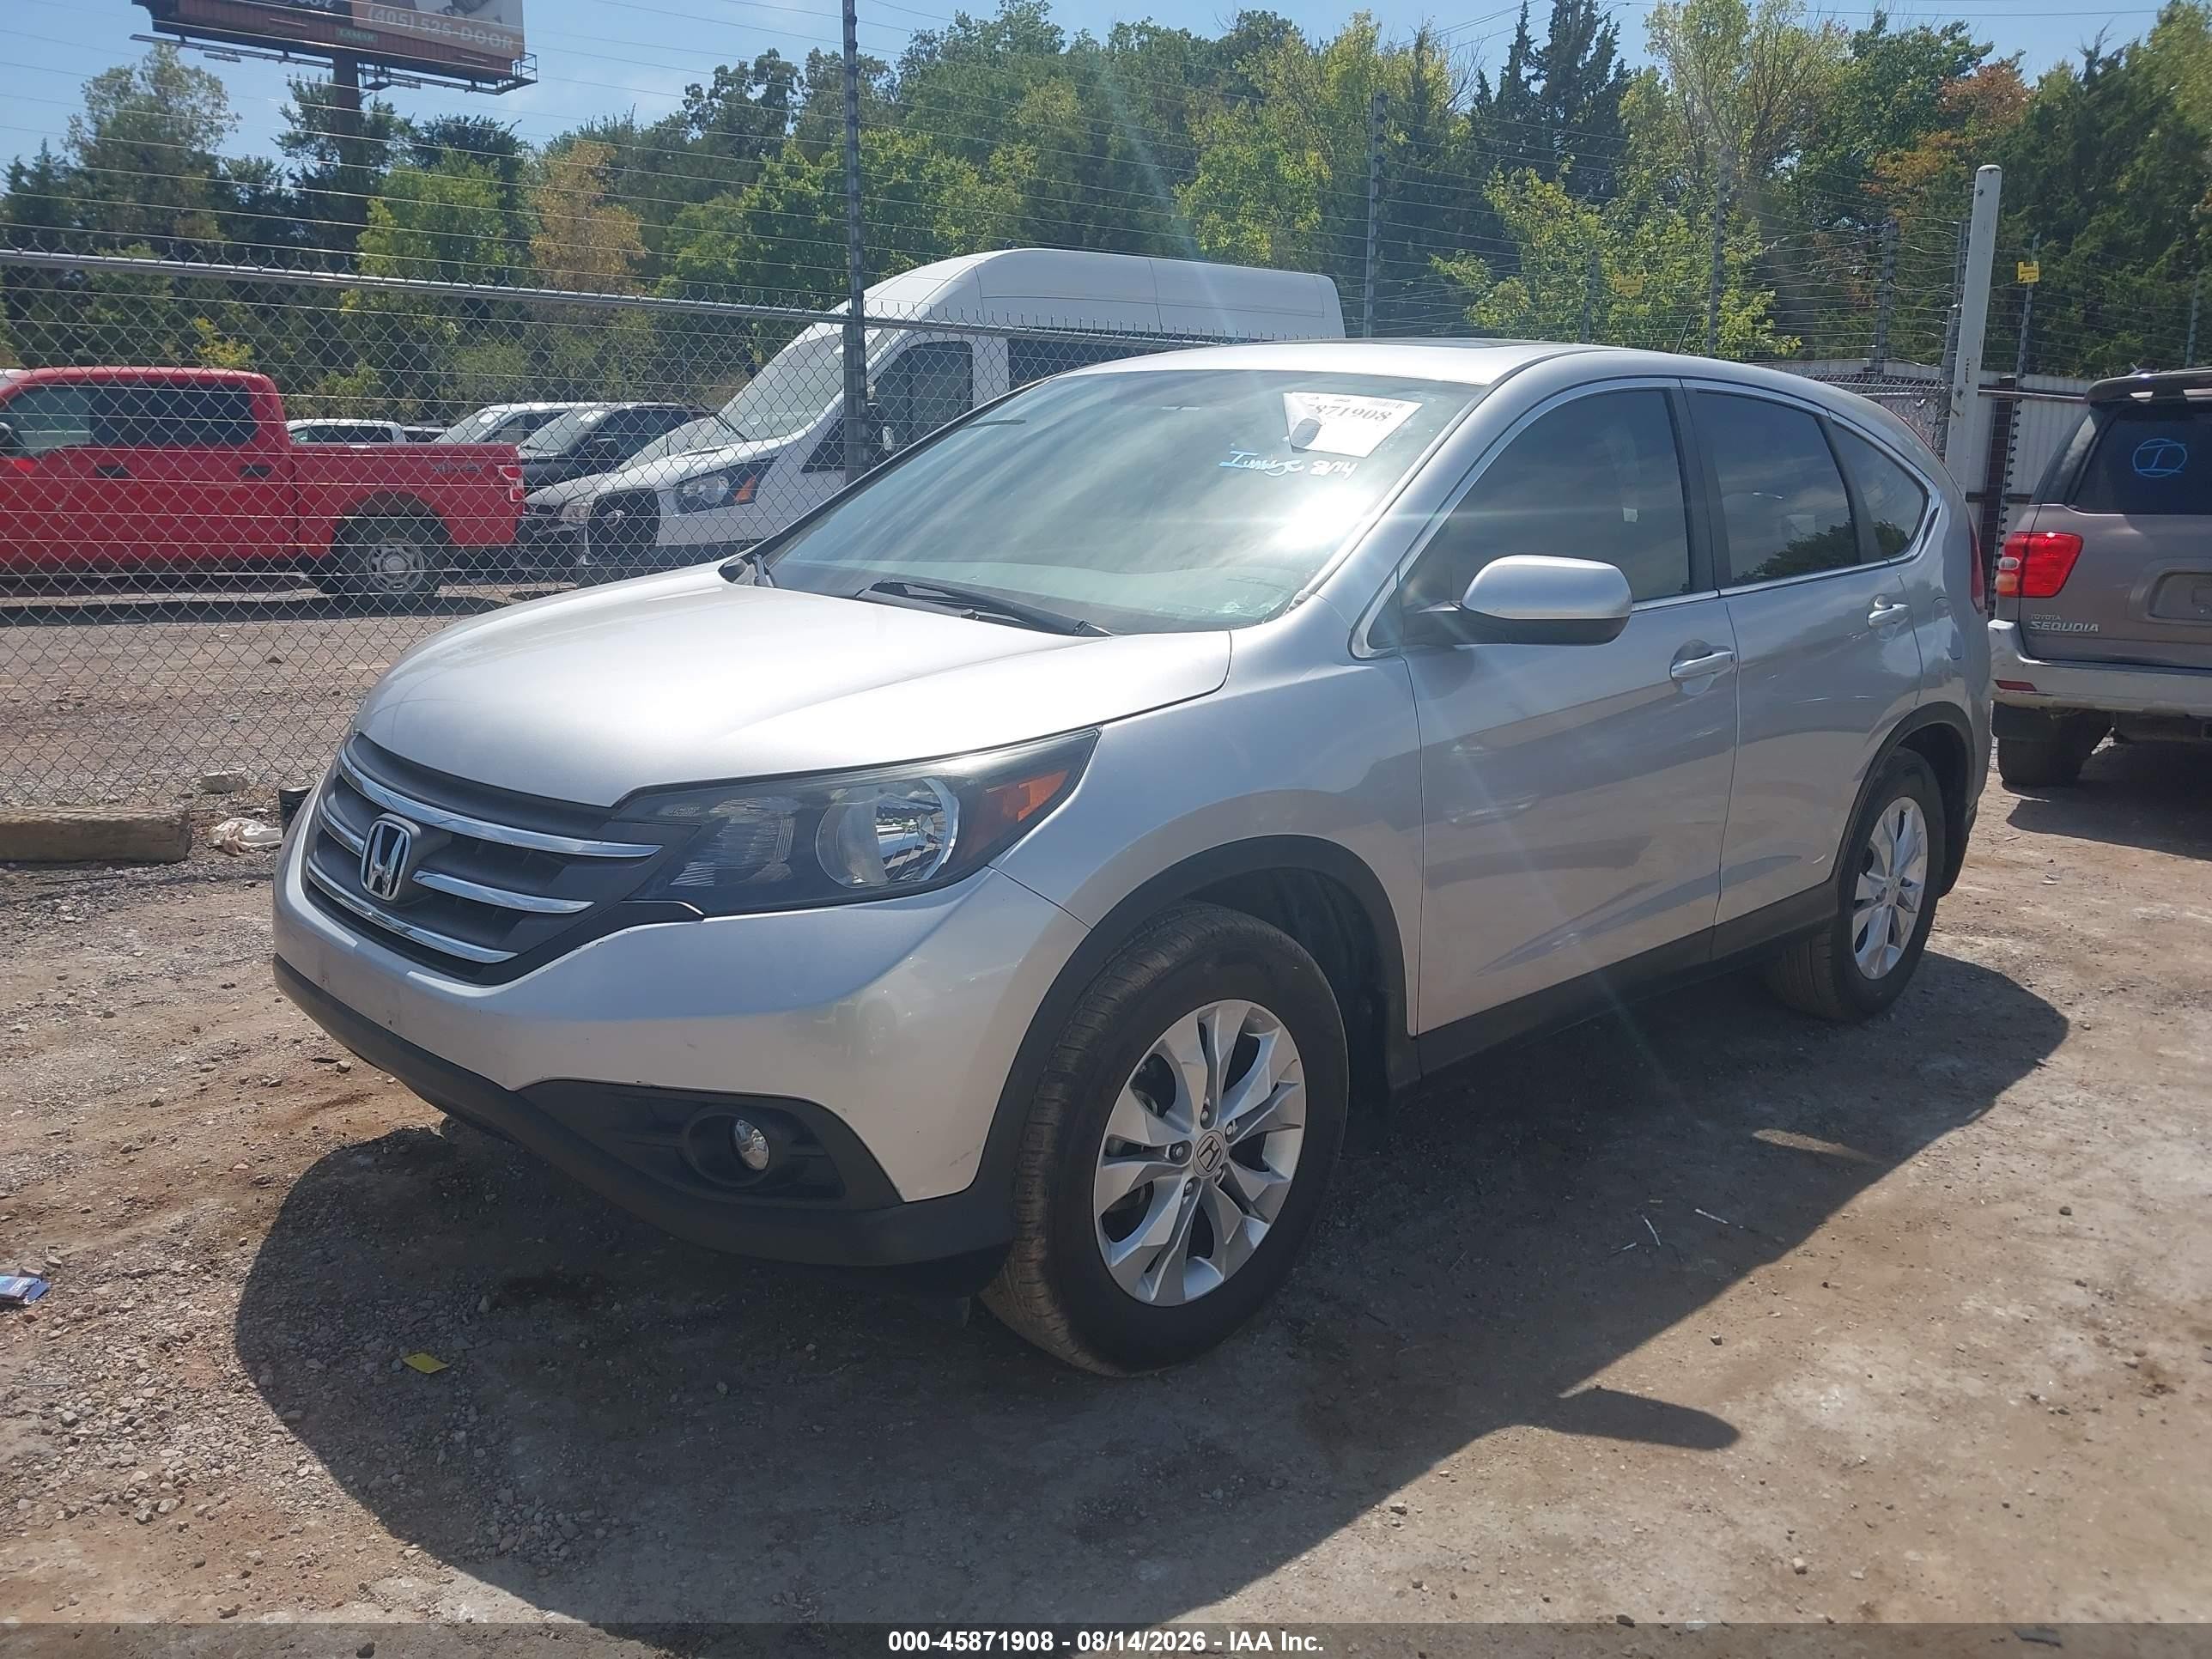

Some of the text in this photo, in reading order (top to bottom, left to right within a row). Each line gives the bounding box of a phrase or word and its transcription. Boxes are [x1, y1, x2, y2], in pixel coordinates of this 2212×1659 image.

[368, 6, 514, 51] (405) 525-DOOR
[2028, 621, 2100, 632] SEQUOIA
